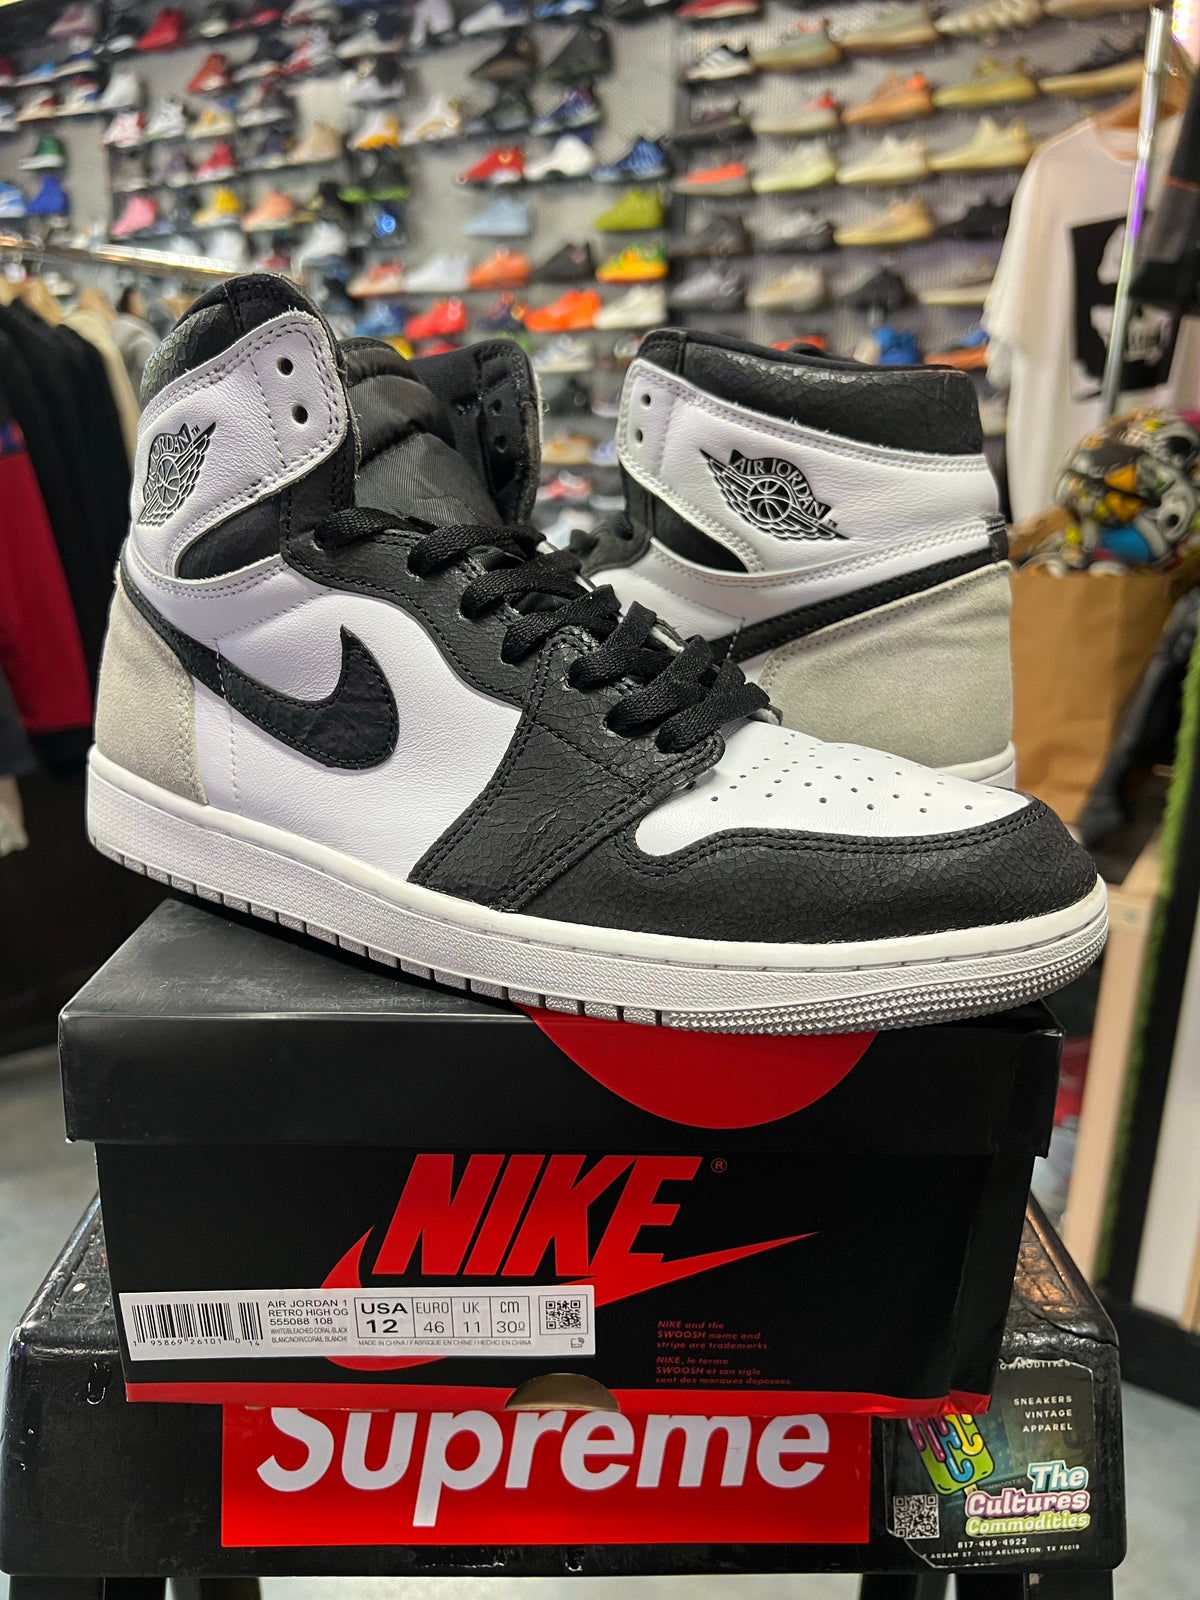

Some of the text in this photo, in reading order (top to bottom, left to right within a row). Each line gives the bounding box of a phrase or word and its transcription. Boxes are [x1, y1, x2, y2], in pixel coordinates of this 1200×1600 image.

[733, 458, 765, 475] AIR
[770, 458, 825, 518] JORDAN
[372, 1153, 703, 1277] NIKE
[267, 1299, 347, 1308] AIR JORDAN 1
[361, 1302, 408, 1315] USA
[416, 1301, 450, 1314] EURO
[462, 1301, 480, 1314] UK
[268, 1308, 349, 1317] RETRO HIGH OG
[270, 1317, 333, 1326] 555088 108
[366, 1318, 399, 1334] 12
[423, 1320, 445, 1334] 46
[463, 1320, 480, 1334] 11
[657, 1320, 725, 1329] NIKE and the
[657, 1330, 706, 1338] SWOOSH
[741, 1332, 761, 1340] and
[656, 1341, 686, 1349] stripe
[656, 1366, 704, 1374] SWOOSH
[738, 1368, 761, 1376] sigle
[699, 1378, 743, 1386] marques
[1013, 1395, 1072, 1406] SNEAKERS
[1025, 1409, 1073, 1419] VINTAGE
[1022, 1423, 1073, 1433] APPAREL
[257, 1406, 831, 1527] Supreme
[1029, 1461, 1087, 1491] The
[967, 1490, 1089, 1517] Cultures
[968, 1512, 1089, 1536] Commodities
